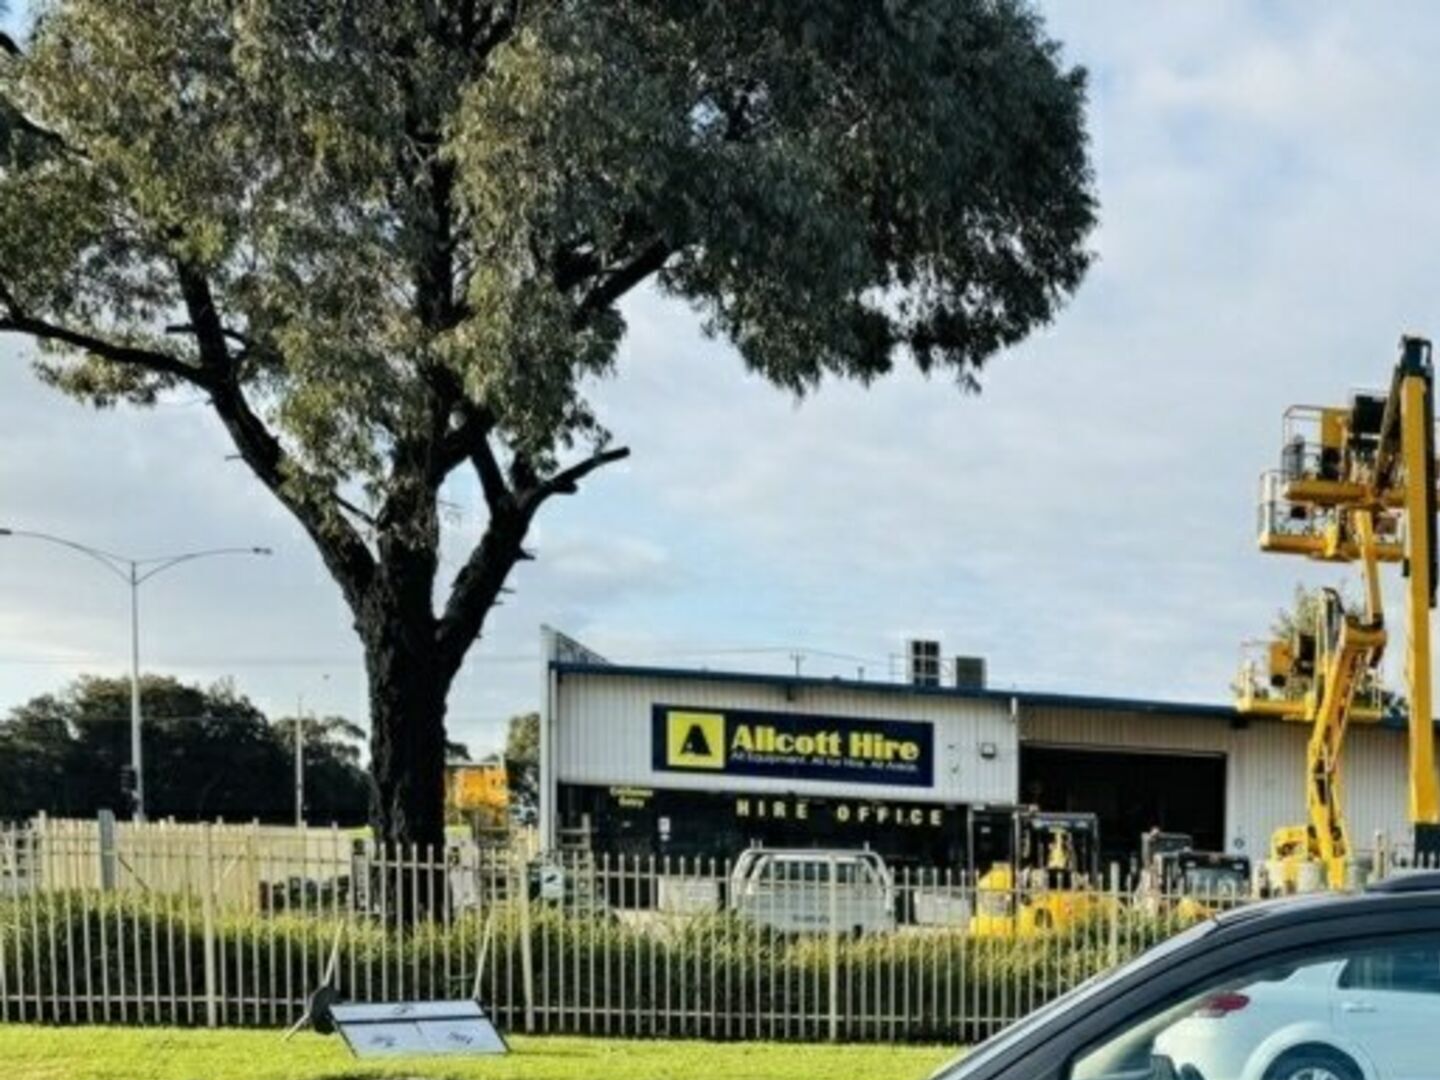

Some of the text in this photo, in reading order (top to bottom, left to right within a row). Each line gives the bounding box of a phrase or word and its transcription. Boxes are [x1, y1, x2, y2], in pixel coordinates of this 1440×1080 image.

[732, 724, 920, 761] Allcott Hire
[736, 799, 942, 826] HIRE OFFICE
